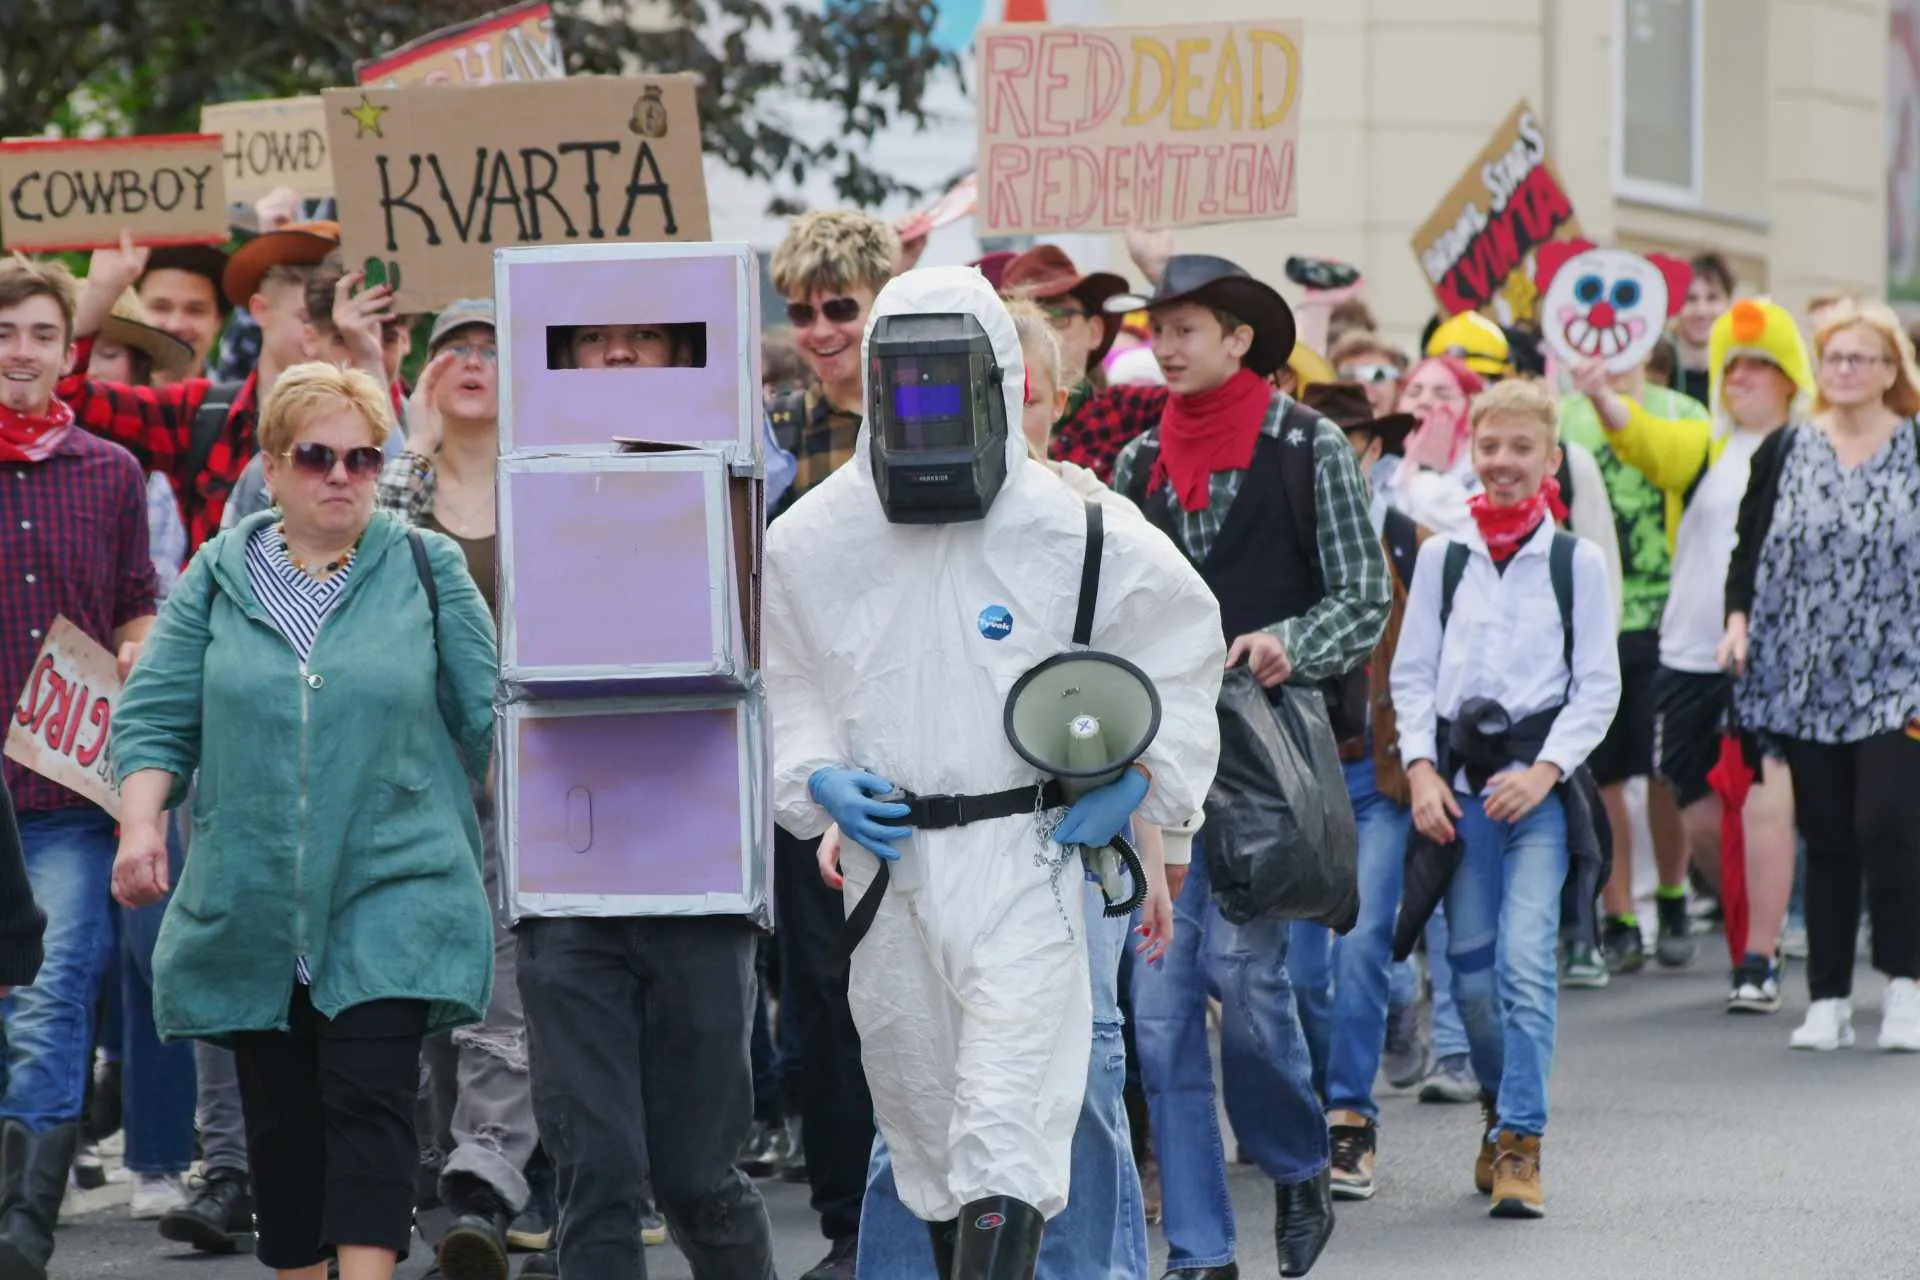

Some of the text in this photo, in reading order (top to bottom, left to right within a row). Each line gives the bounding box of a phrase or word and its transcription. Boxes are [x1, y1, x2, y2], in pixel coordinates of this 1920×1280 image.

[986, 27, 1299, 138] RED DEAD
[10, 165, 212, 222] COWBOY
[376, 141, 677, 251] KVARTA
[987, 140, 1295, 229] REDEMTION
[16, 653, 109, 768] GIRLS
